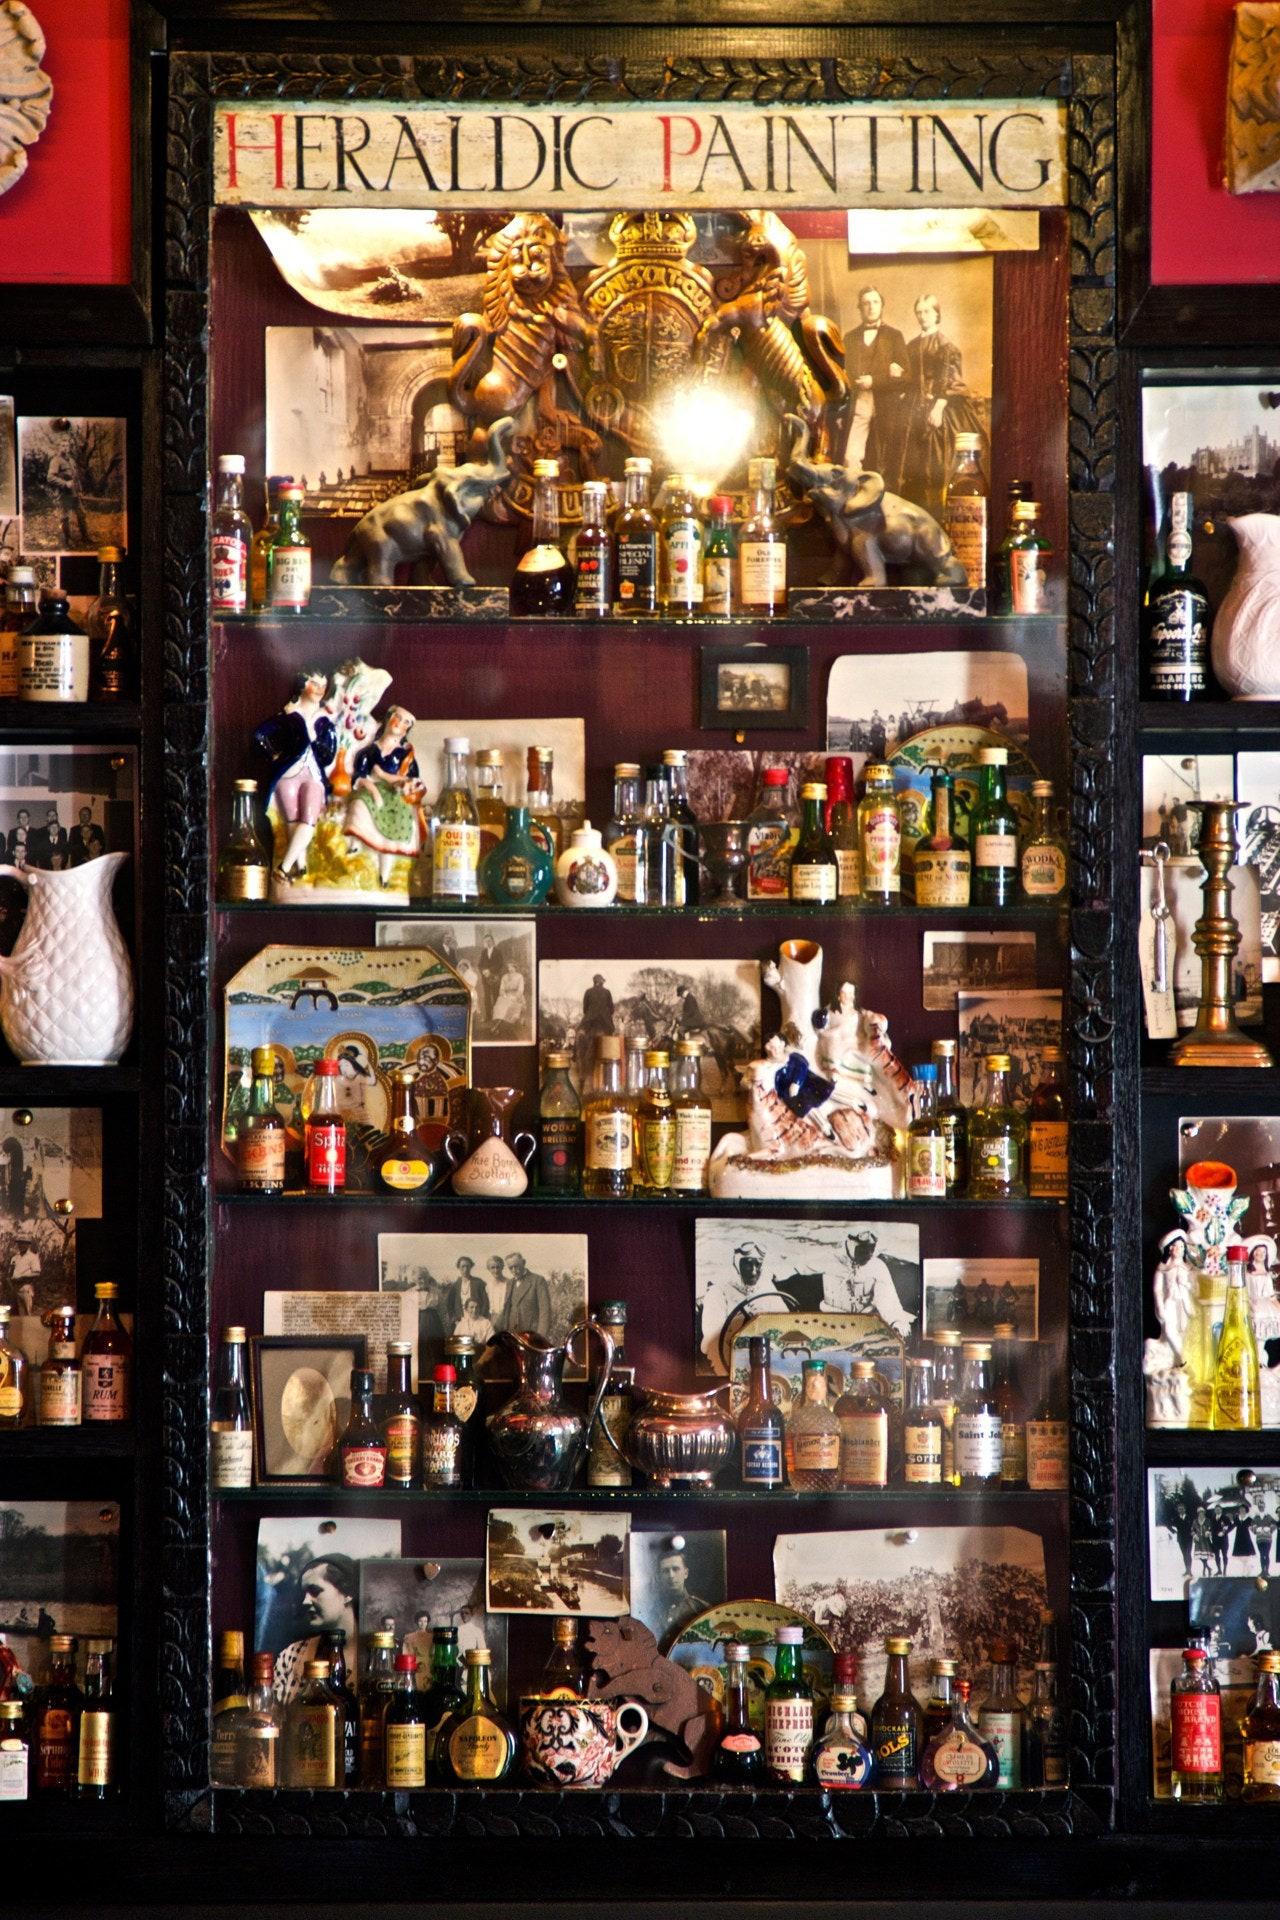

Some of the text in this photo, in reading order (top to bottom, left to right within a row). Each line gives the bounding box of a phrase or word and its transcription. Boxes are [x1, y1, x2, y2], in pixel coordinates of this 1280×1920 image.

[225, 112, 1053, 193] HERALDIC PAINTING
[542, 1123, 577, 1132] WODKA
[91, 1389, 118, 1400] RUM
[957, 1430, 985, 1439] Saint
